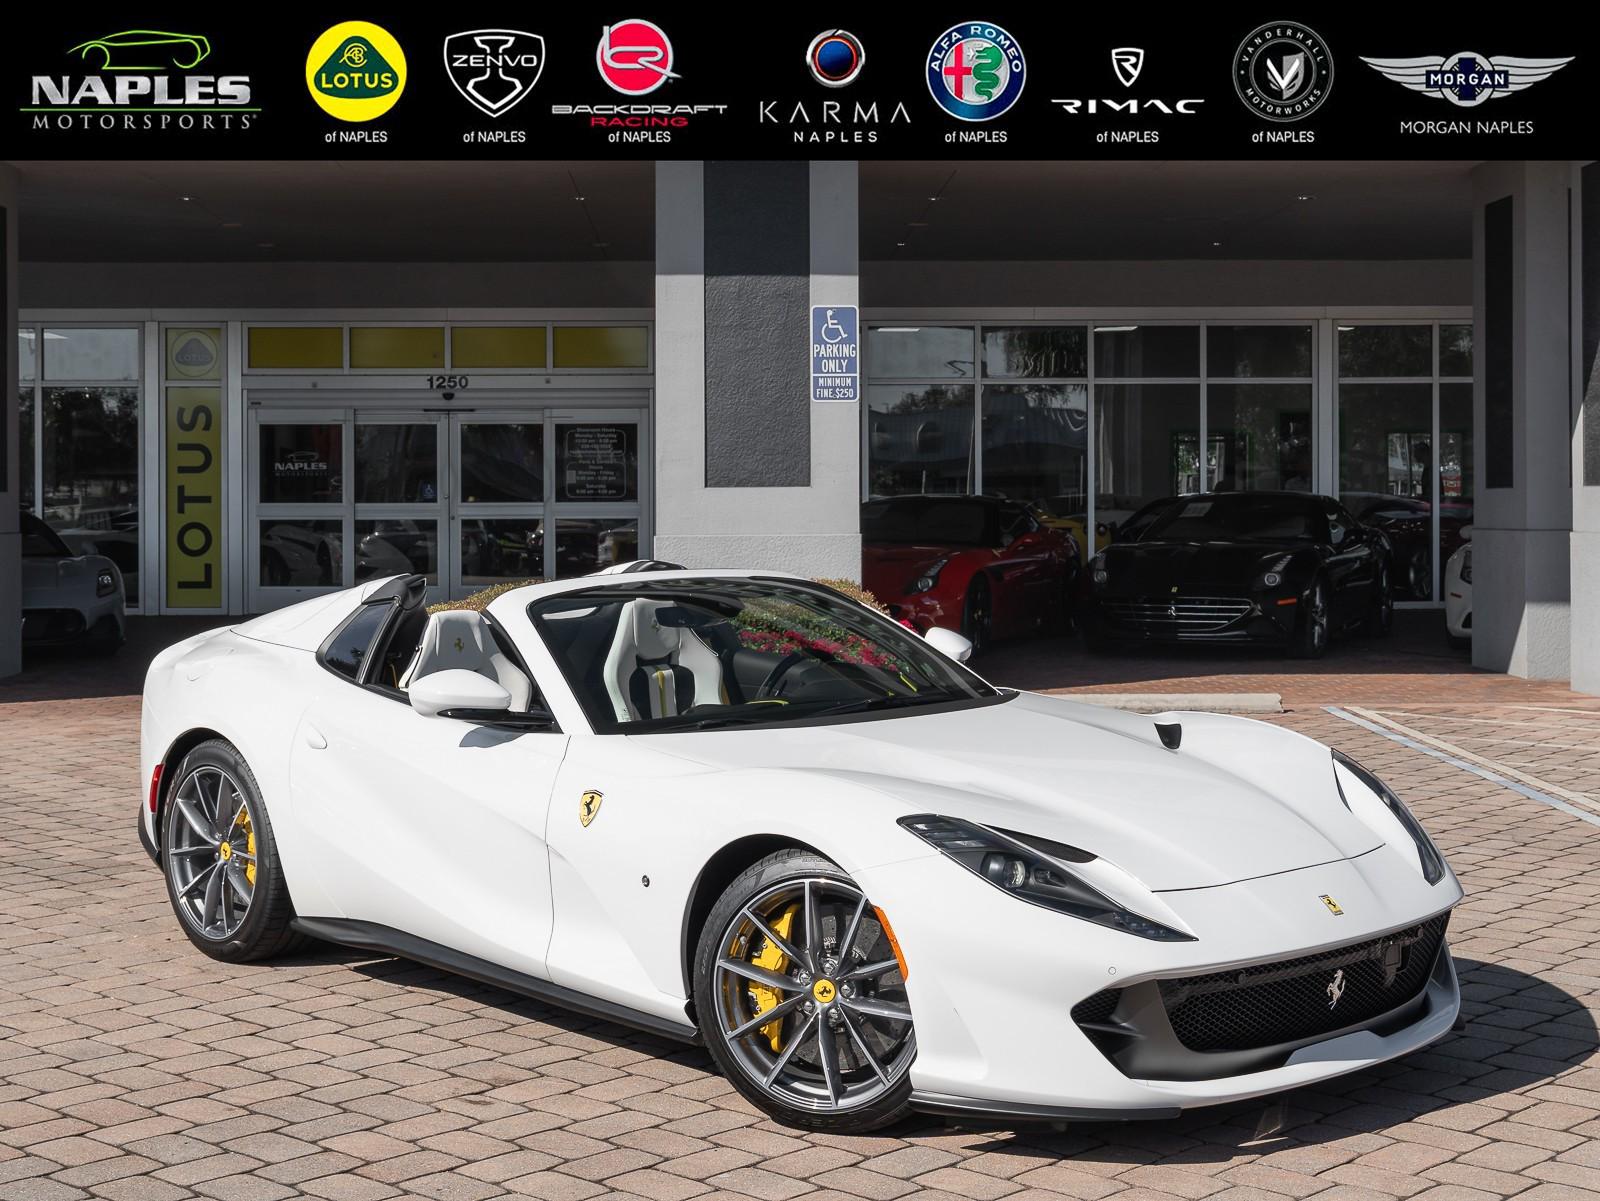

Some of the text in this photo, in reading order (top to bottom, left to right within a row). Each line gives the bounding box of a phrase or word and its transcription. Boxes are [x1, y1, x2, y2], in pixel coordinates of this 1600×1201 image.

[813, 344, 856, 357] PARKING
[821, 359, 848, 372] ONLY
[427, 376, 468, 389] 1250
[818, 377, 851, 386] MINIMUM
[816, 388, 853, 399] FINE $250
[274, 462, 328, 470] NAPLES
[177, 405, 213, 589] LOTUS
